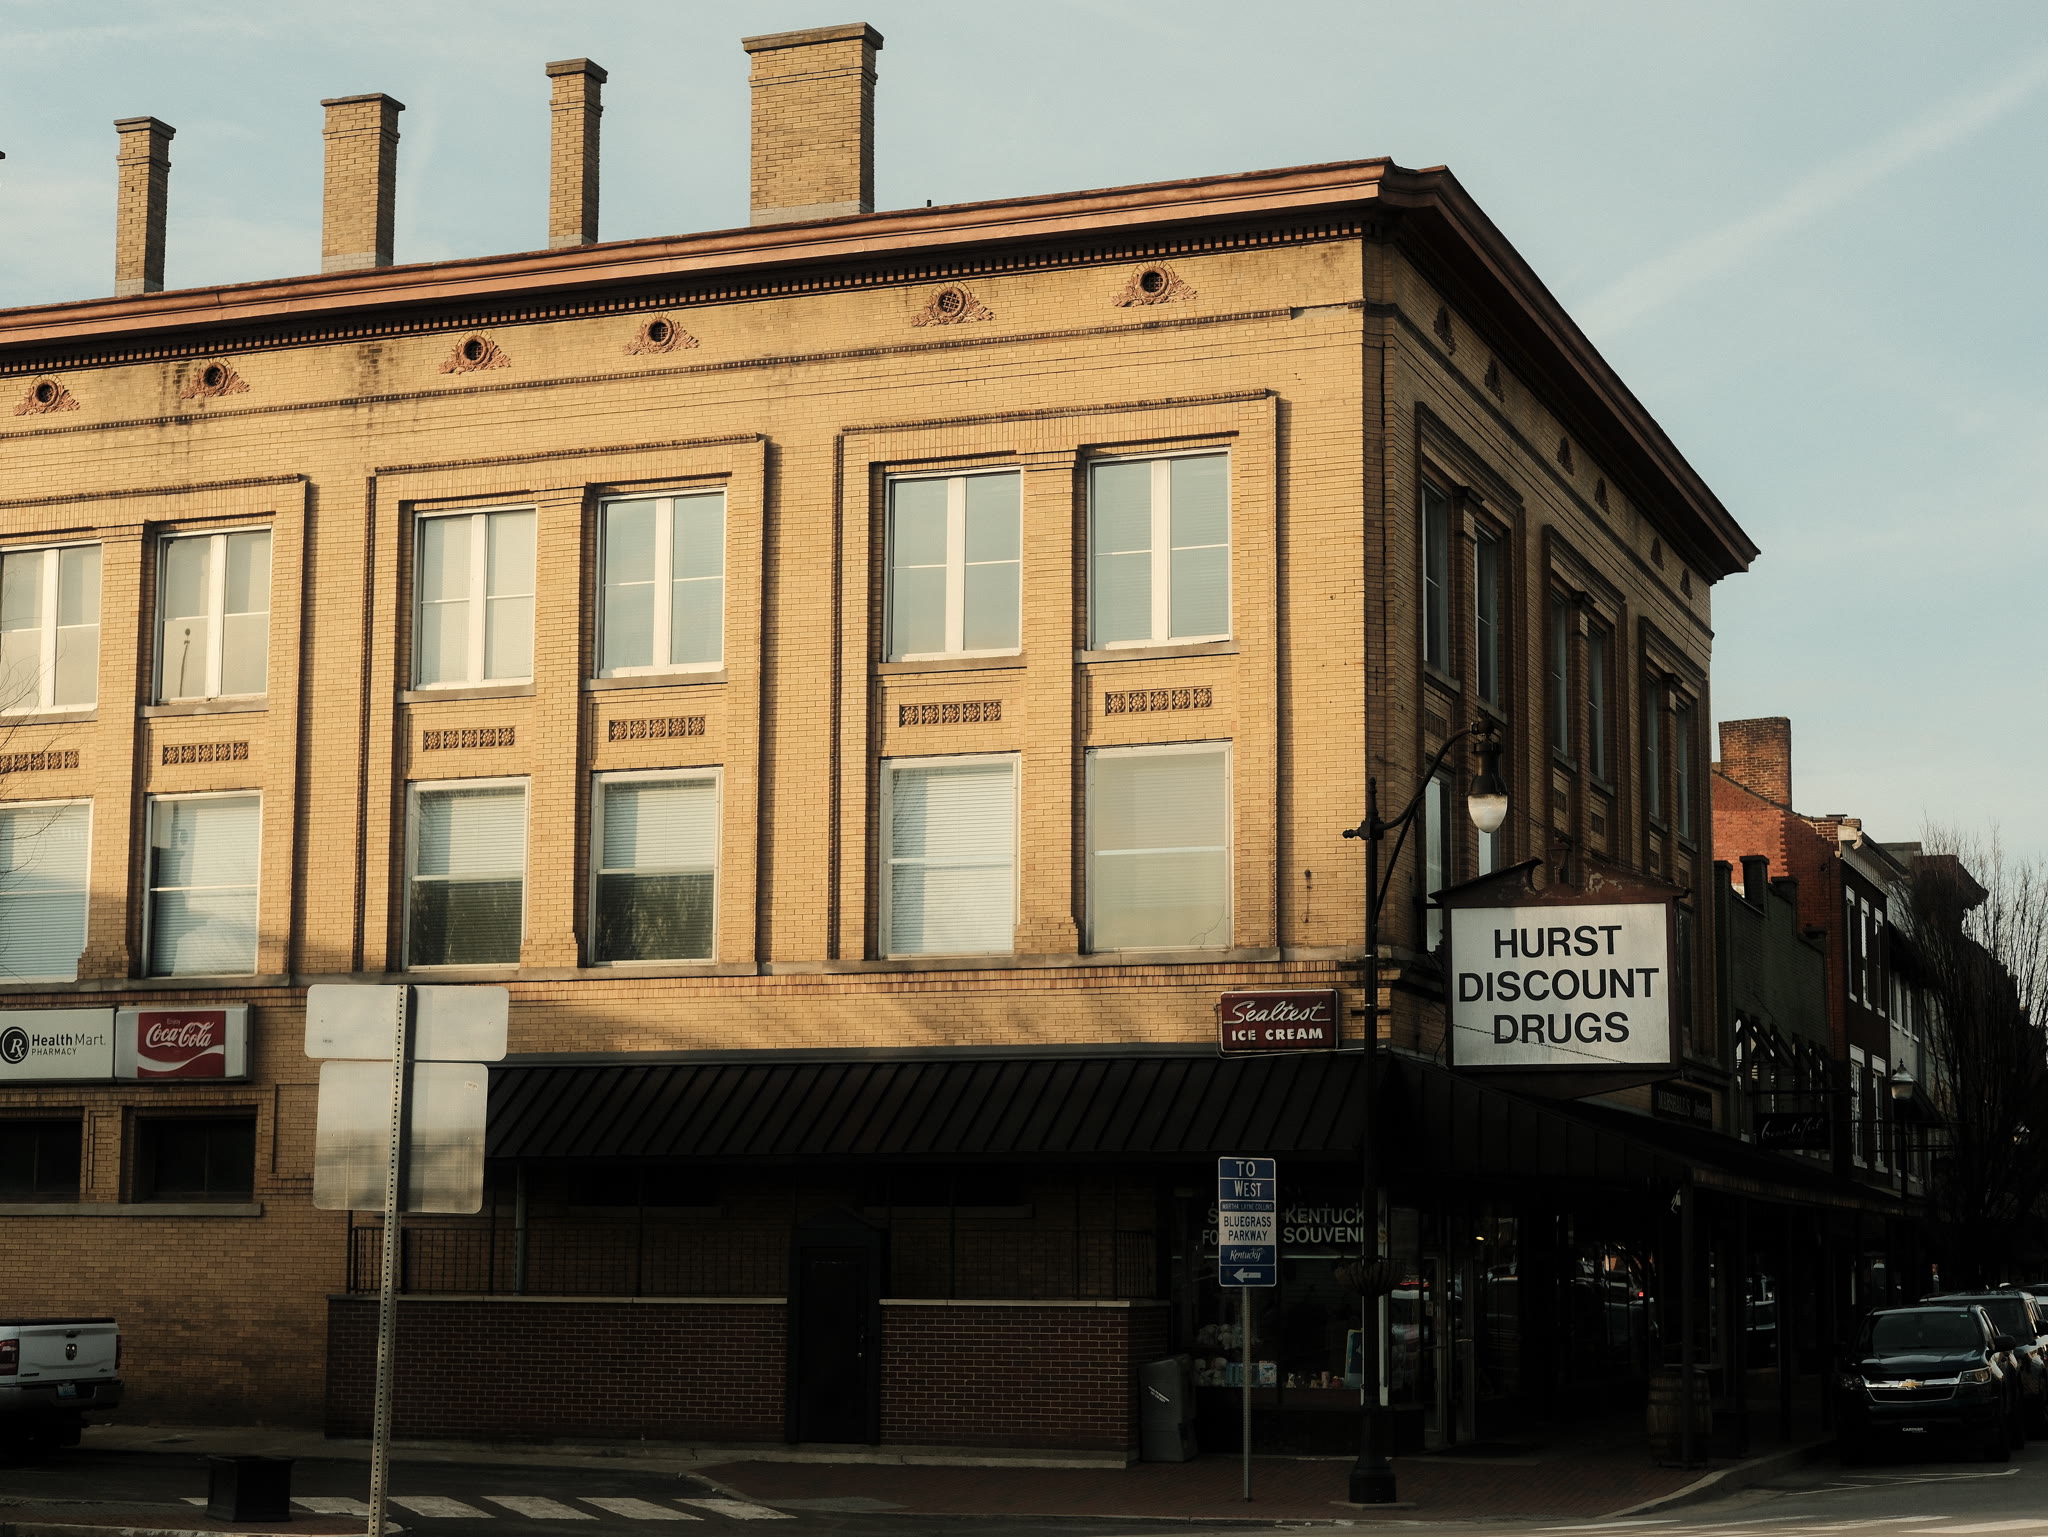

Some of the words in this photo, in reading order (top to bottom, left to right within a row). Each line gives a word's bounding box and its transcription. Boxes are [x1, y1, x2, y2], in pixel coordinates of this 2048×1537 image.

[1494, 925, 1622, 959] HURST
[1459, 967, 1659, 1002] DISCOUNT
[1223, 1000, 1331, 1024] Sealtest
[166, 1018, 182, 1026] Enjoy
[1494, 1011, 1629, 1044] DRUGS
[145, 1021, 215, 1048] Coca-Cola
[1231, 1029, 1256, 1041] ICE
[1265, 1027, 1323, 1041] CREAM
[31, 1047, 77, 1056] PHARMACY
[1236, 1160, 1256, 1177] TO
[1234, 1179, 1262, 1198] WEST
[1222, 1203, 1239, 1211] MARTHA
[1241, 1203, 1255, 1211] LAYNE
[1255, 1203, 1273, 1211] COLLINS
[1285, 1207, 1364, 1224] KENTUCK
[1224, 1216, 1272, 1227] BLUEGRASS
[1228, 1230, 1268, 1242] PARKWAY
[1229, 1248, 1261, 1262] Kentucky
